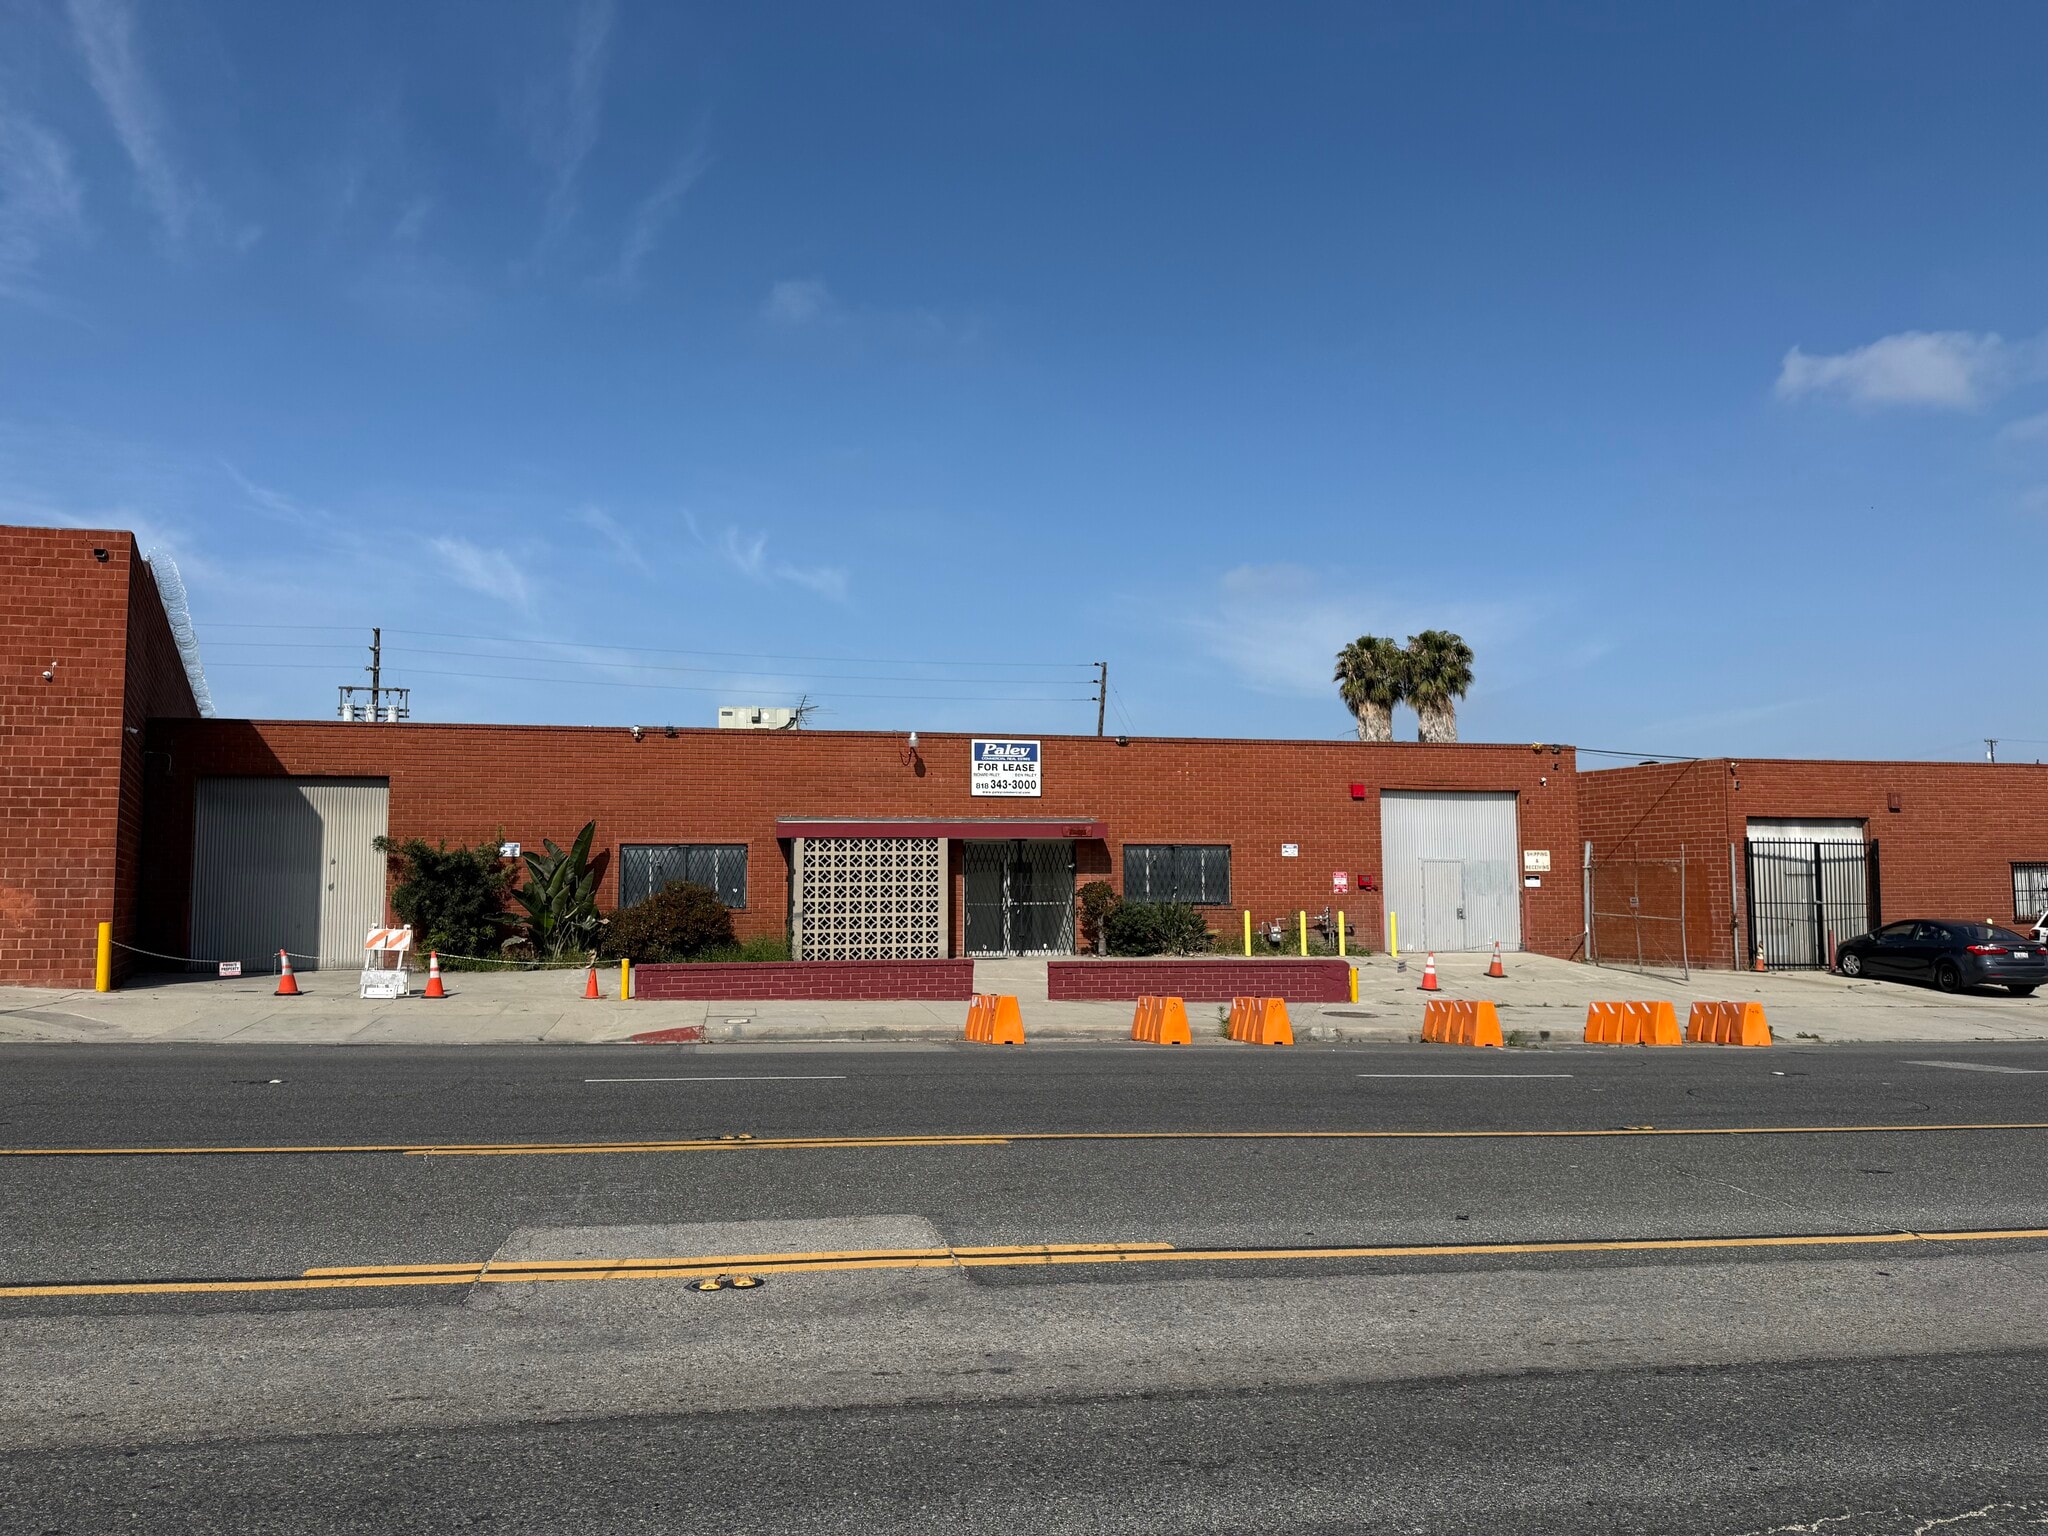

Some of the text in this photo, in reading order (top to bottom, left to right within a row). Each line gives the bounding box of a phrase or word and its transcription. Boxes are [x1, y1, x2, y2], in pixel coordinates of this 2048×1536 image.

[983, 743, 1030, 757] Paley
[977, 763, 1035, 772] FOR LEASE
[990, 780, 1037, 790] 343-3000
